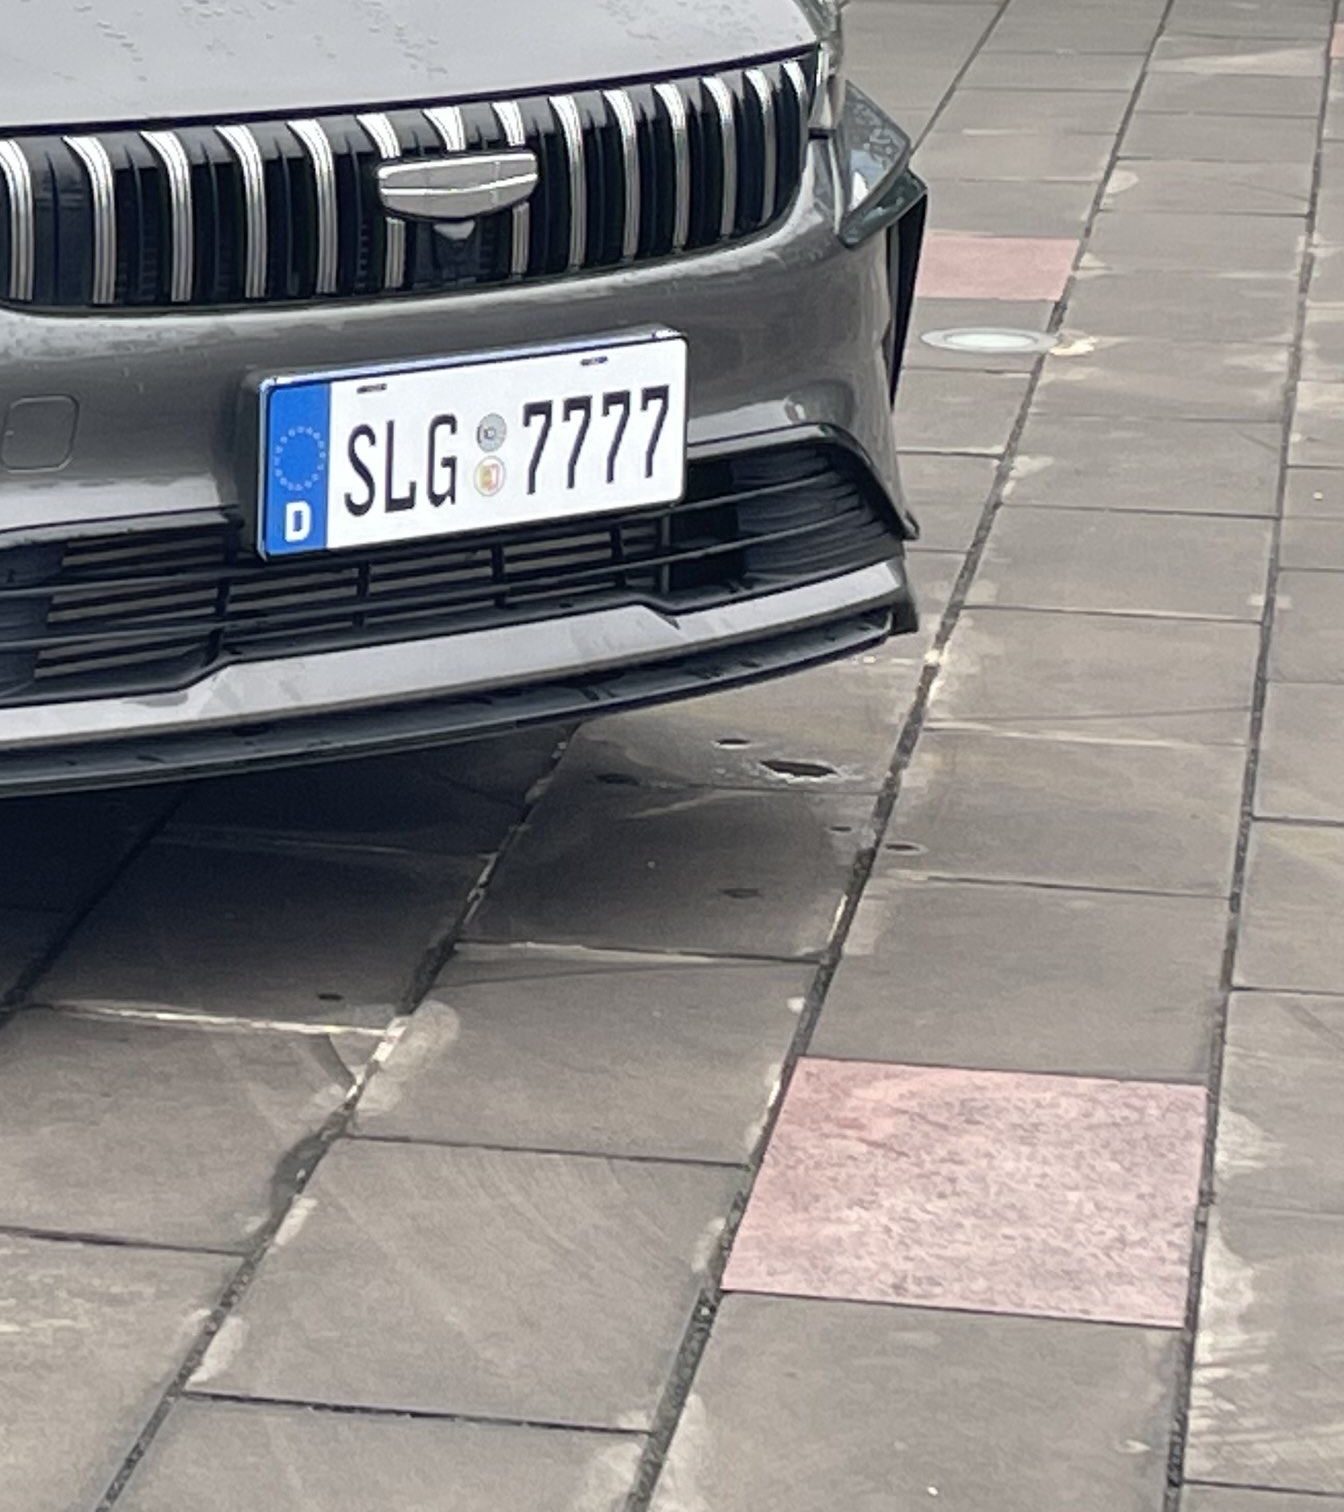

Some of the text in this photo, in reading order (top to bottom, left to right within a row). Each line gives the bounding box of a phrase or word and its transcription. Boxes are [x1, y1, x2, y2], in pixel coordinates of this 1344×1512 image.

[344, 384, 670, 517] SLG 7777
[284, 500, 311, 543] D
